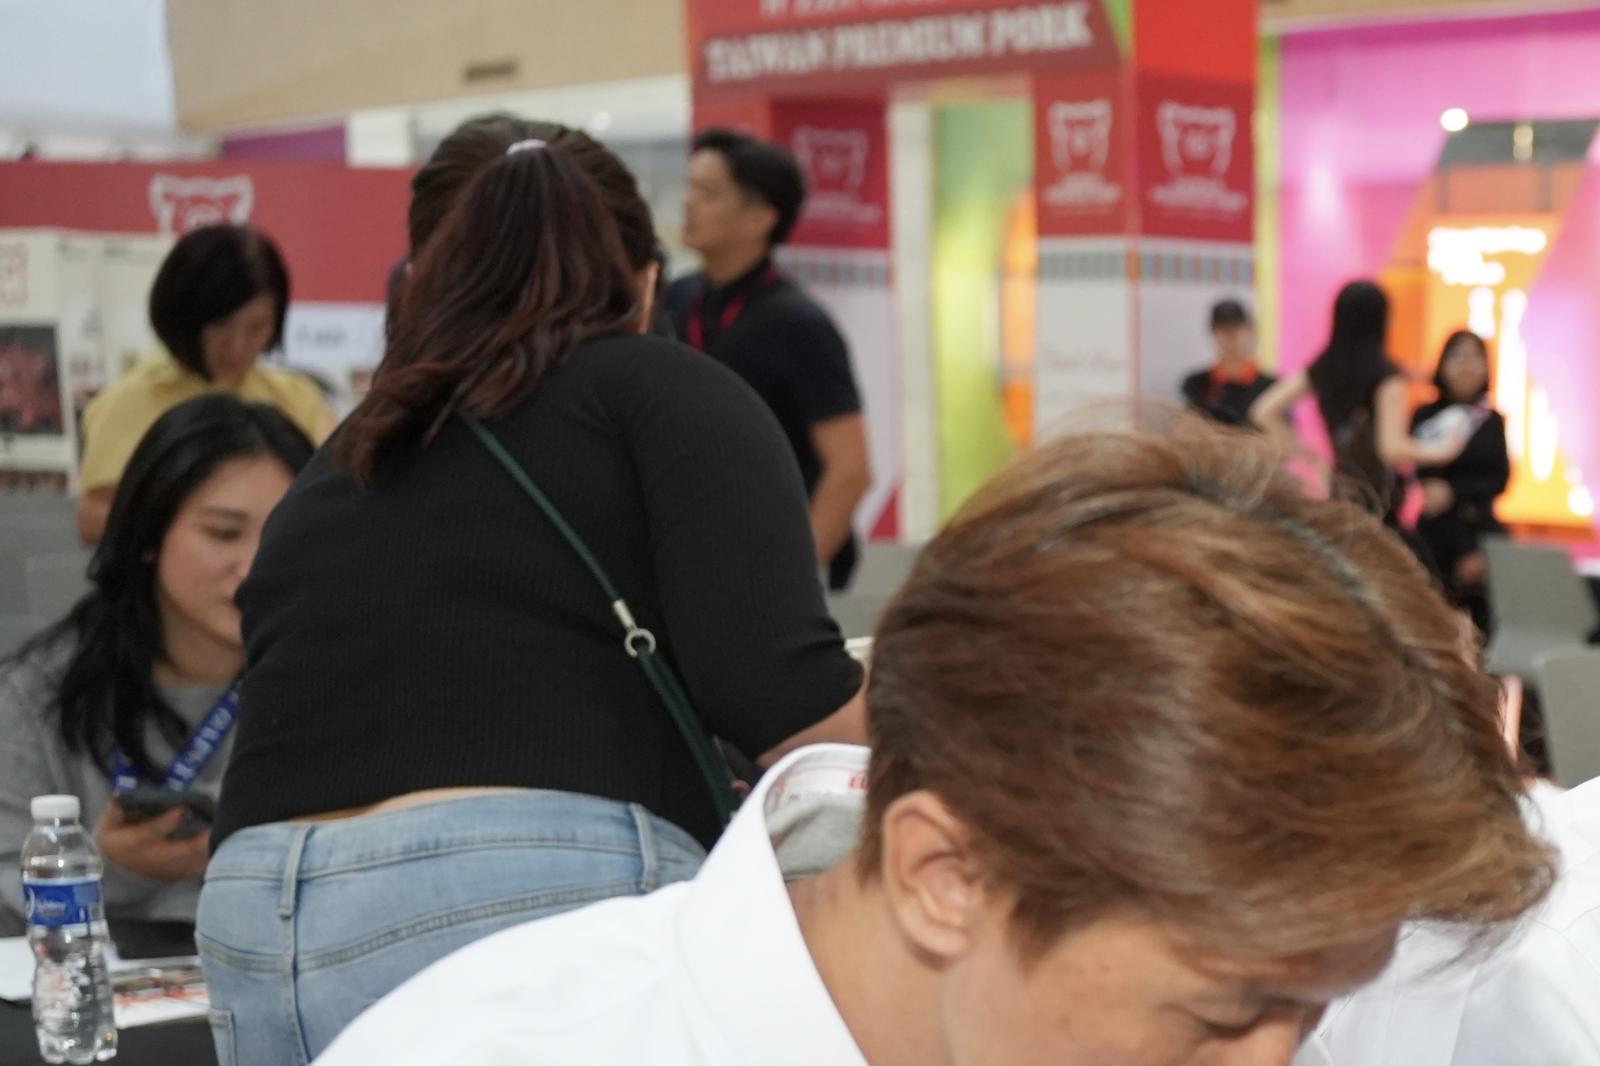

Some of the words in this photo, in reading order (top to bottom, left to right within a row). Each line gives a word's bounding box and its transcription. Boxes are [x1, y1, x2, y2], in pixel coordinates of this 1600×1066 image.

[706, 29, 828, 82] TAIWAN
[833, 15, 987, 71] PREMIUM
[991, 2, 1093, 55] PORK
